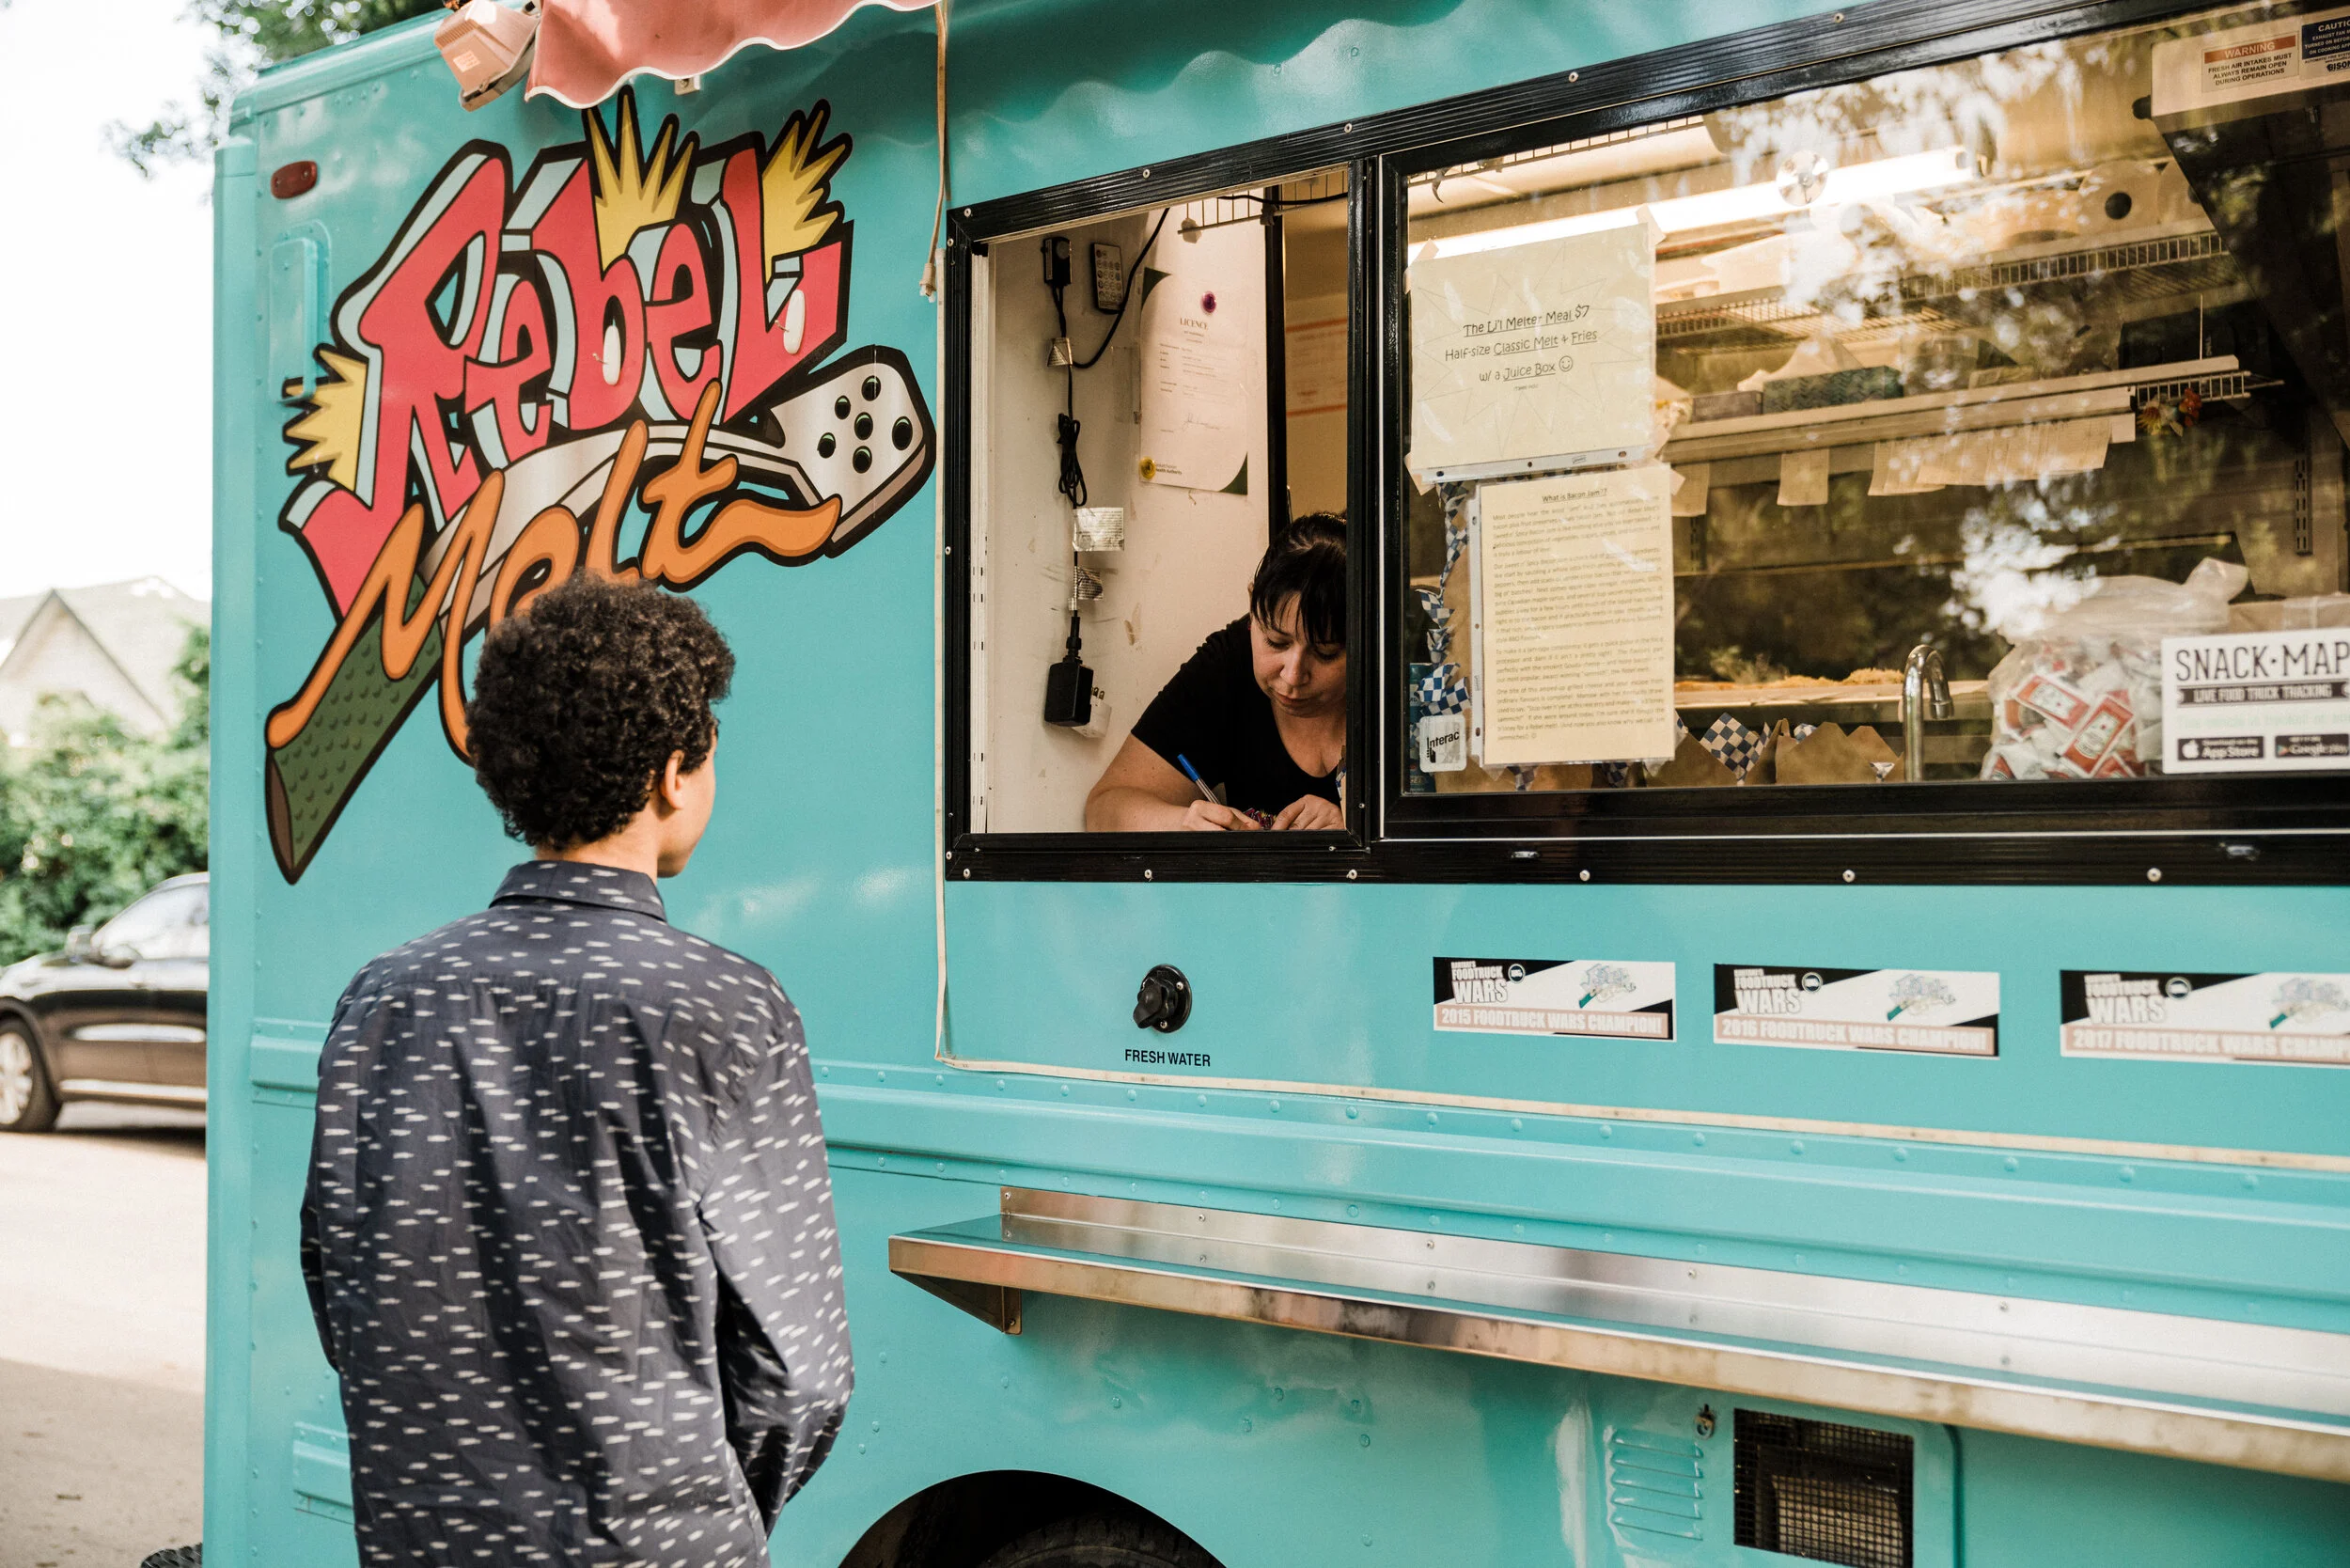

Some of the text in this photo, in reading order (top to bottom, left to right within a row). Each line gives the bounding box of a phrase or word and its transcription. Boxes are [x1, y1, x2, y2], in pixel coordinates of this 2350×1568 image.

[2305, 41, 2325, 50] TURNED
[2312, 32, 2335, 41] EXHAUST
[2225, 41, 2276, 58] WARNING
[2318, 45, 2341, 54] COOKING
[2209, 65, 2230, 73] FRESH
[2244, 56, 2272, 67] INTAKES
[2274, 53, 2293, 61] MUST
[2213, 60, 2287, 80] ALWAYS REMAIN OPEN
[2216, 68, 2285, 86] DURING OPERATIONS
[1464, 323, 1483, 336] The
[1506, 315, 1542, 329] Melter
[1546, 310, 1572, 324] Meal
[1574, 305, 1590, 320] $7
[1446, 345, 1490, 361] Half-size
[1494, 339, 1530, 355] Classic
[1534, 337, 1559, 351] Melt
[1572, 330, 1597, 344] Fries
[1480, 363, 1556, 382] w/ a Juice Box
[1542, 494, 1559, 503] What
[1567, 491, 1586, 499] Bacon
[1426, 731, 1460, 749] Interac
[1451, 966, 1503, 980] FOODTRUCK
[1451, 979, 1508, 1004] WARS
[1734, 988, 1801, 1014] WARS
[2085, 995, 2166, 1024] WARS
[1442, 1008, 1662, 1034] 2015 FOODTRUCK WARS CHAMPION!
[1722, 1019, 1986, 1051] 2016 FOODTRUCK WARS CHAMPION!
[2074, 1029, 2113, 1048] 2017
[2115, 1030, 2219, 1053] FOODTRUCK
[2222, 1036, 2277, 1056] WARS
[1125, 1049, 1211, 1067] FRESH WATER
